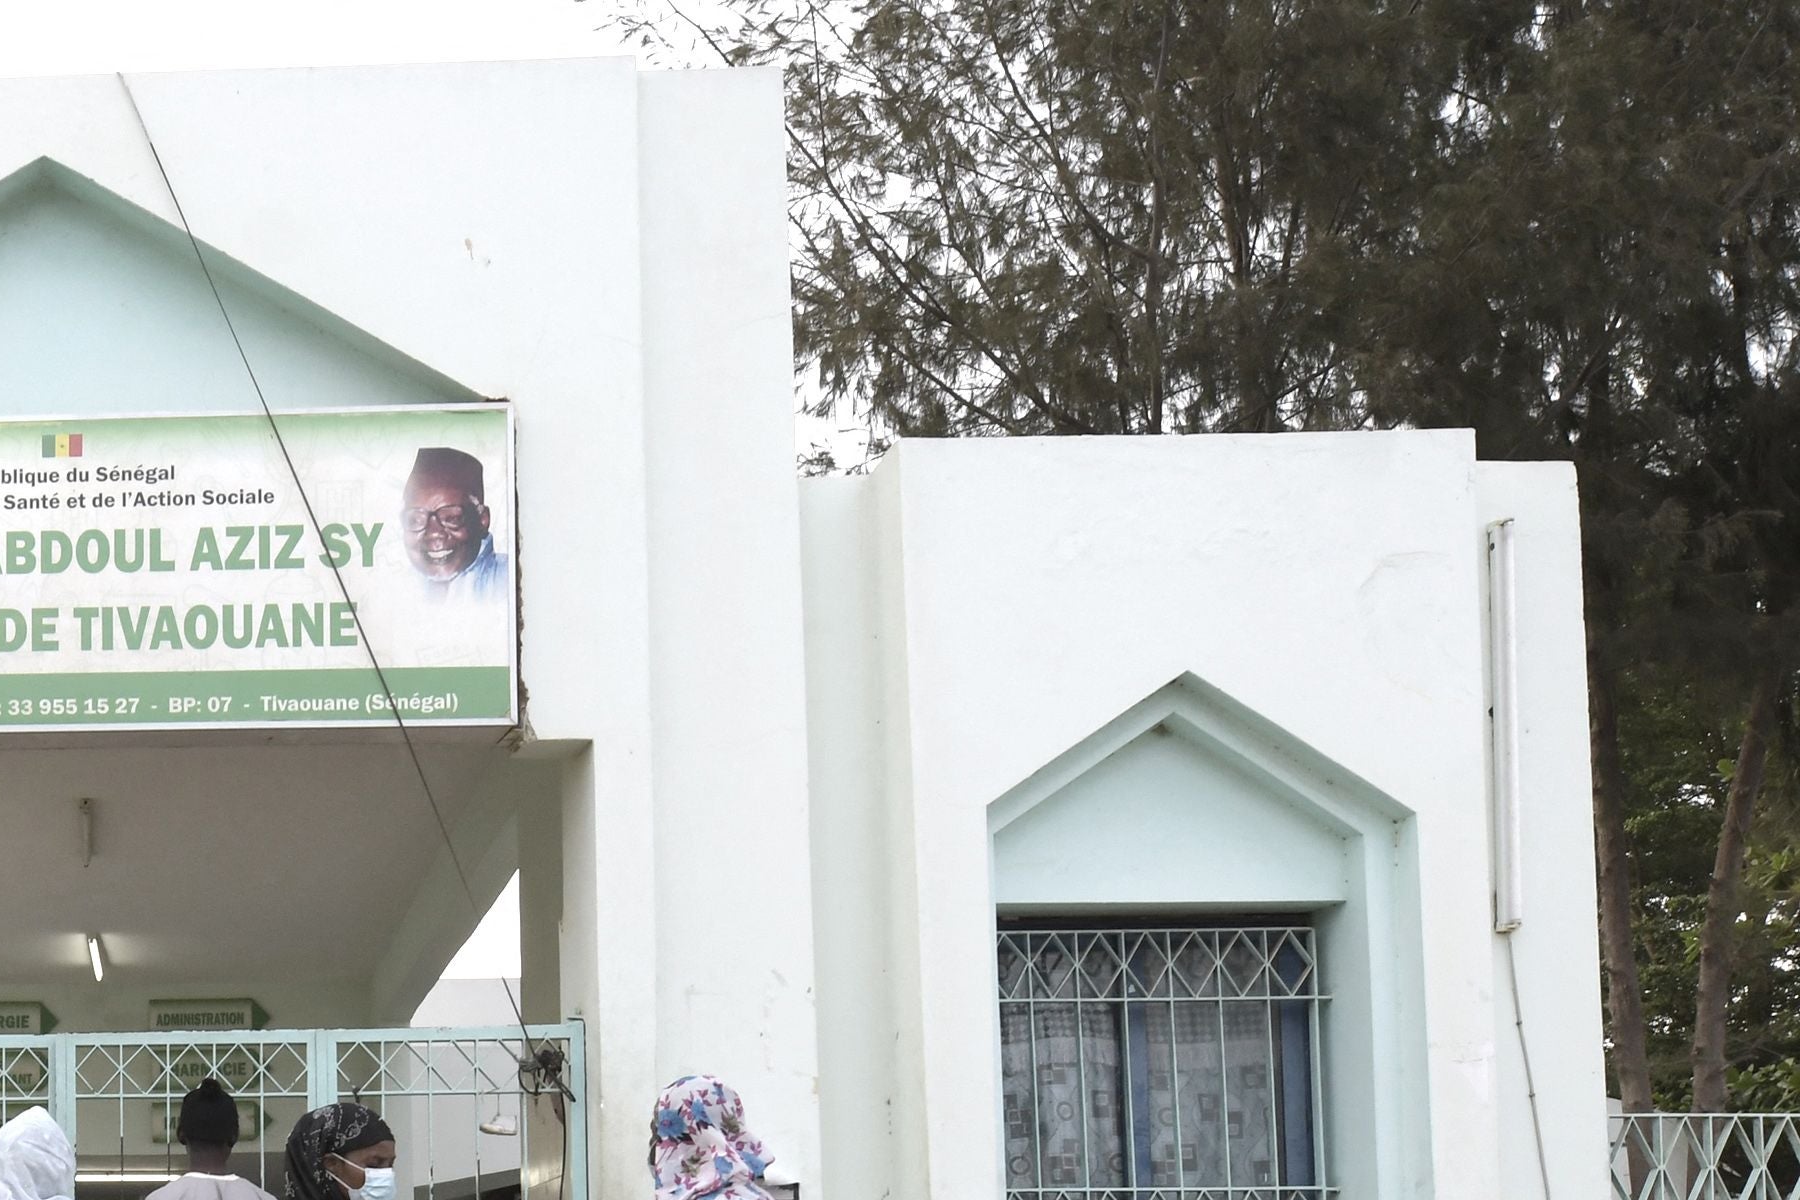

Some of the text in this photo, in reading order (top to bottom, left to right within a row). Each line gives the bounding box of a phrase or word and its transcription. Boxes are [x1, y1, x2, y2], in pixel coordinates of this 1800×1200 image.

[66, 467, 89, 483] du
[96, 465, 175, 485] Sénégal
[4, 493, 60, 510] Santé
[66, 493, 86, 509] et
[92, 492, 115, 508] de
[122, 490, 195, 507] l'Action
[202, 488, 275, 505] Sociale
[191, 525, 305, 571] AZIZ
[318, 523, 383, 568] SY
[75, 602, 358, 651] TIVAOUANE
[7, 699, 33, 716] 33
[39, 698, 78, 715] 955
[83, 698, 110, 715] 15
[114, 697, 140, 714] 27
[168, 697, 201, 713] BP:
[207, 696, 233, 713] 07
[260, 695, 360, 712] Tivaouane
[365, 692, 458, 714] (Sénégal)
[156, 1012, 245, 1026] ADMINISTRATION
[160, 1062, 247, 1077] HARMCIE
